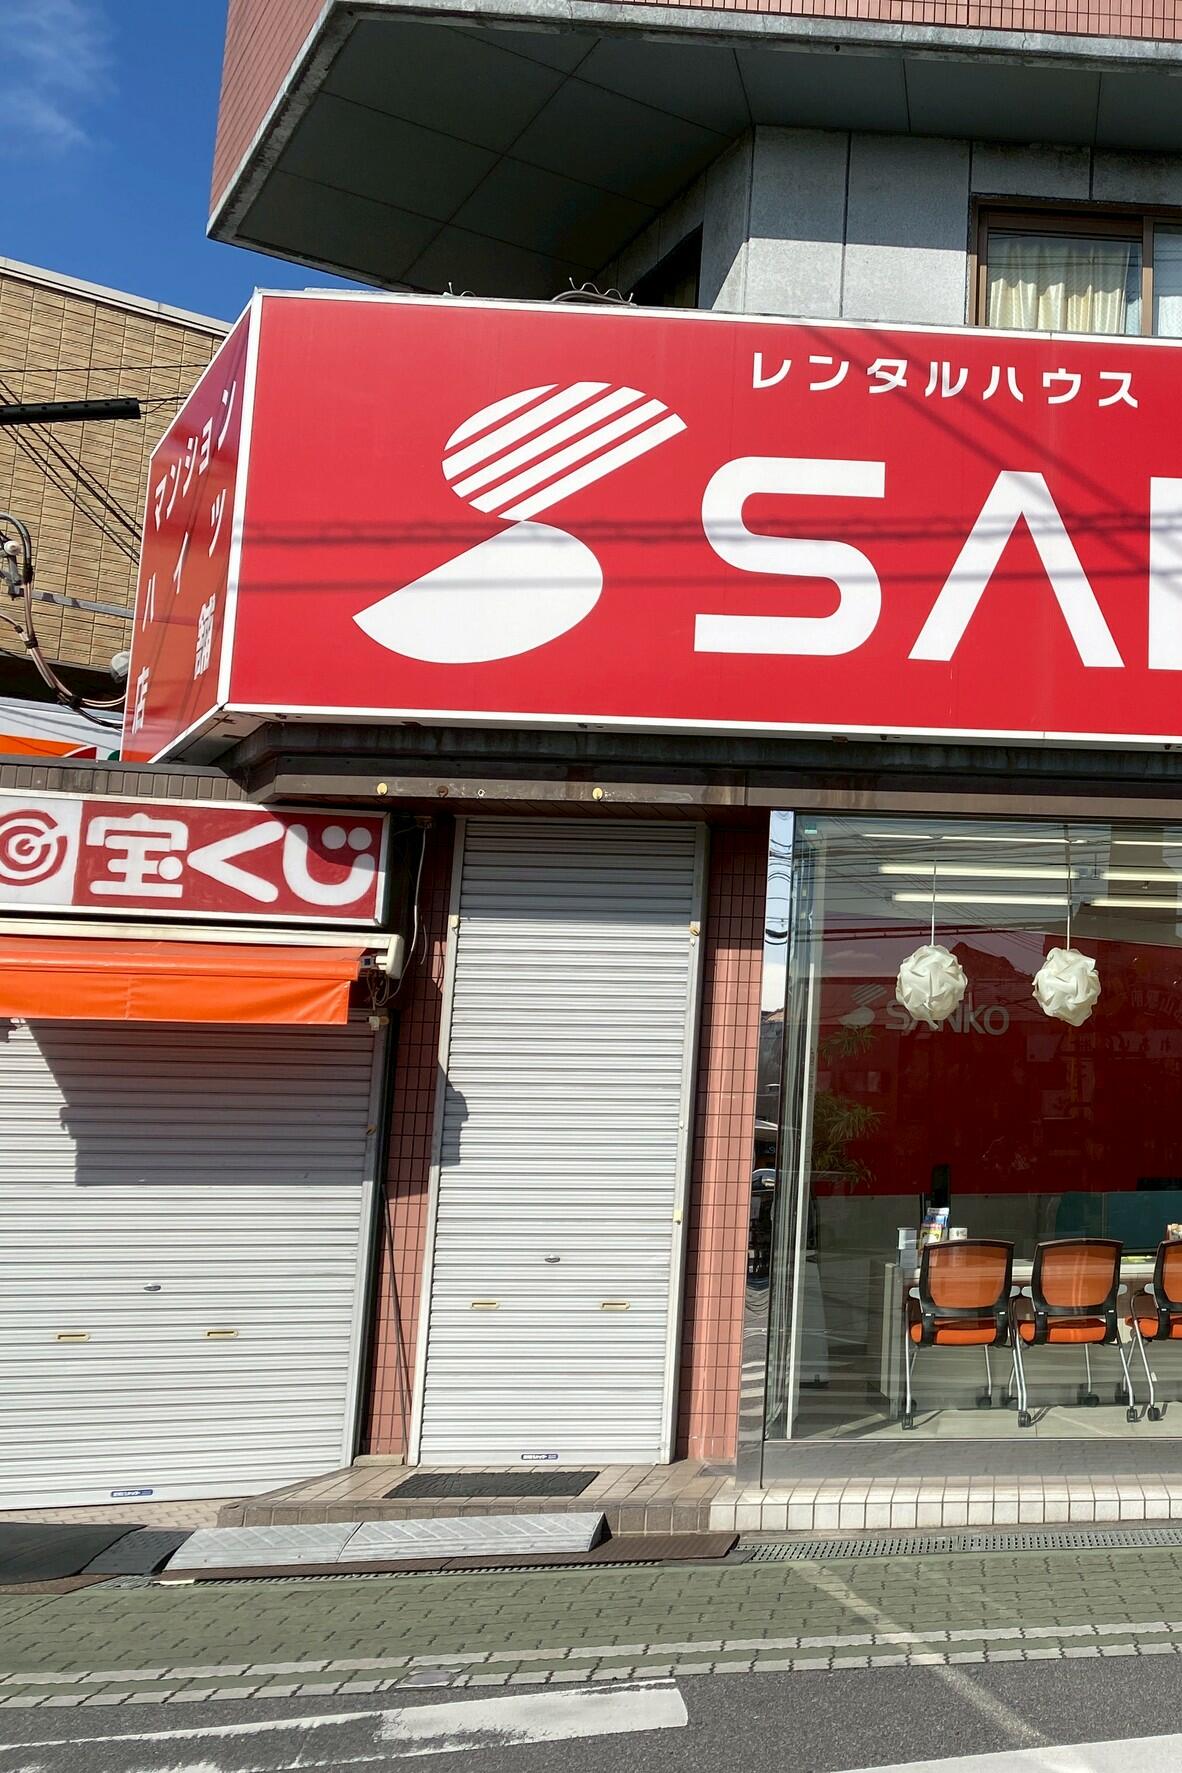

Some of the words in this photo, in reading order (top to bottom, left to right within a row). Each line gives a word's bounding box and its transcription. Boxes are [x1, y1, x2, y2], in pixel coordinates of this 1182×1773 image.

[751, 351, 1139, 409] レンタルハウス
[154, 380, 237, 532] マンション
[85, 812, 376, 907] 宝くじ
[885, 992, 1010, 1036] SNKO
